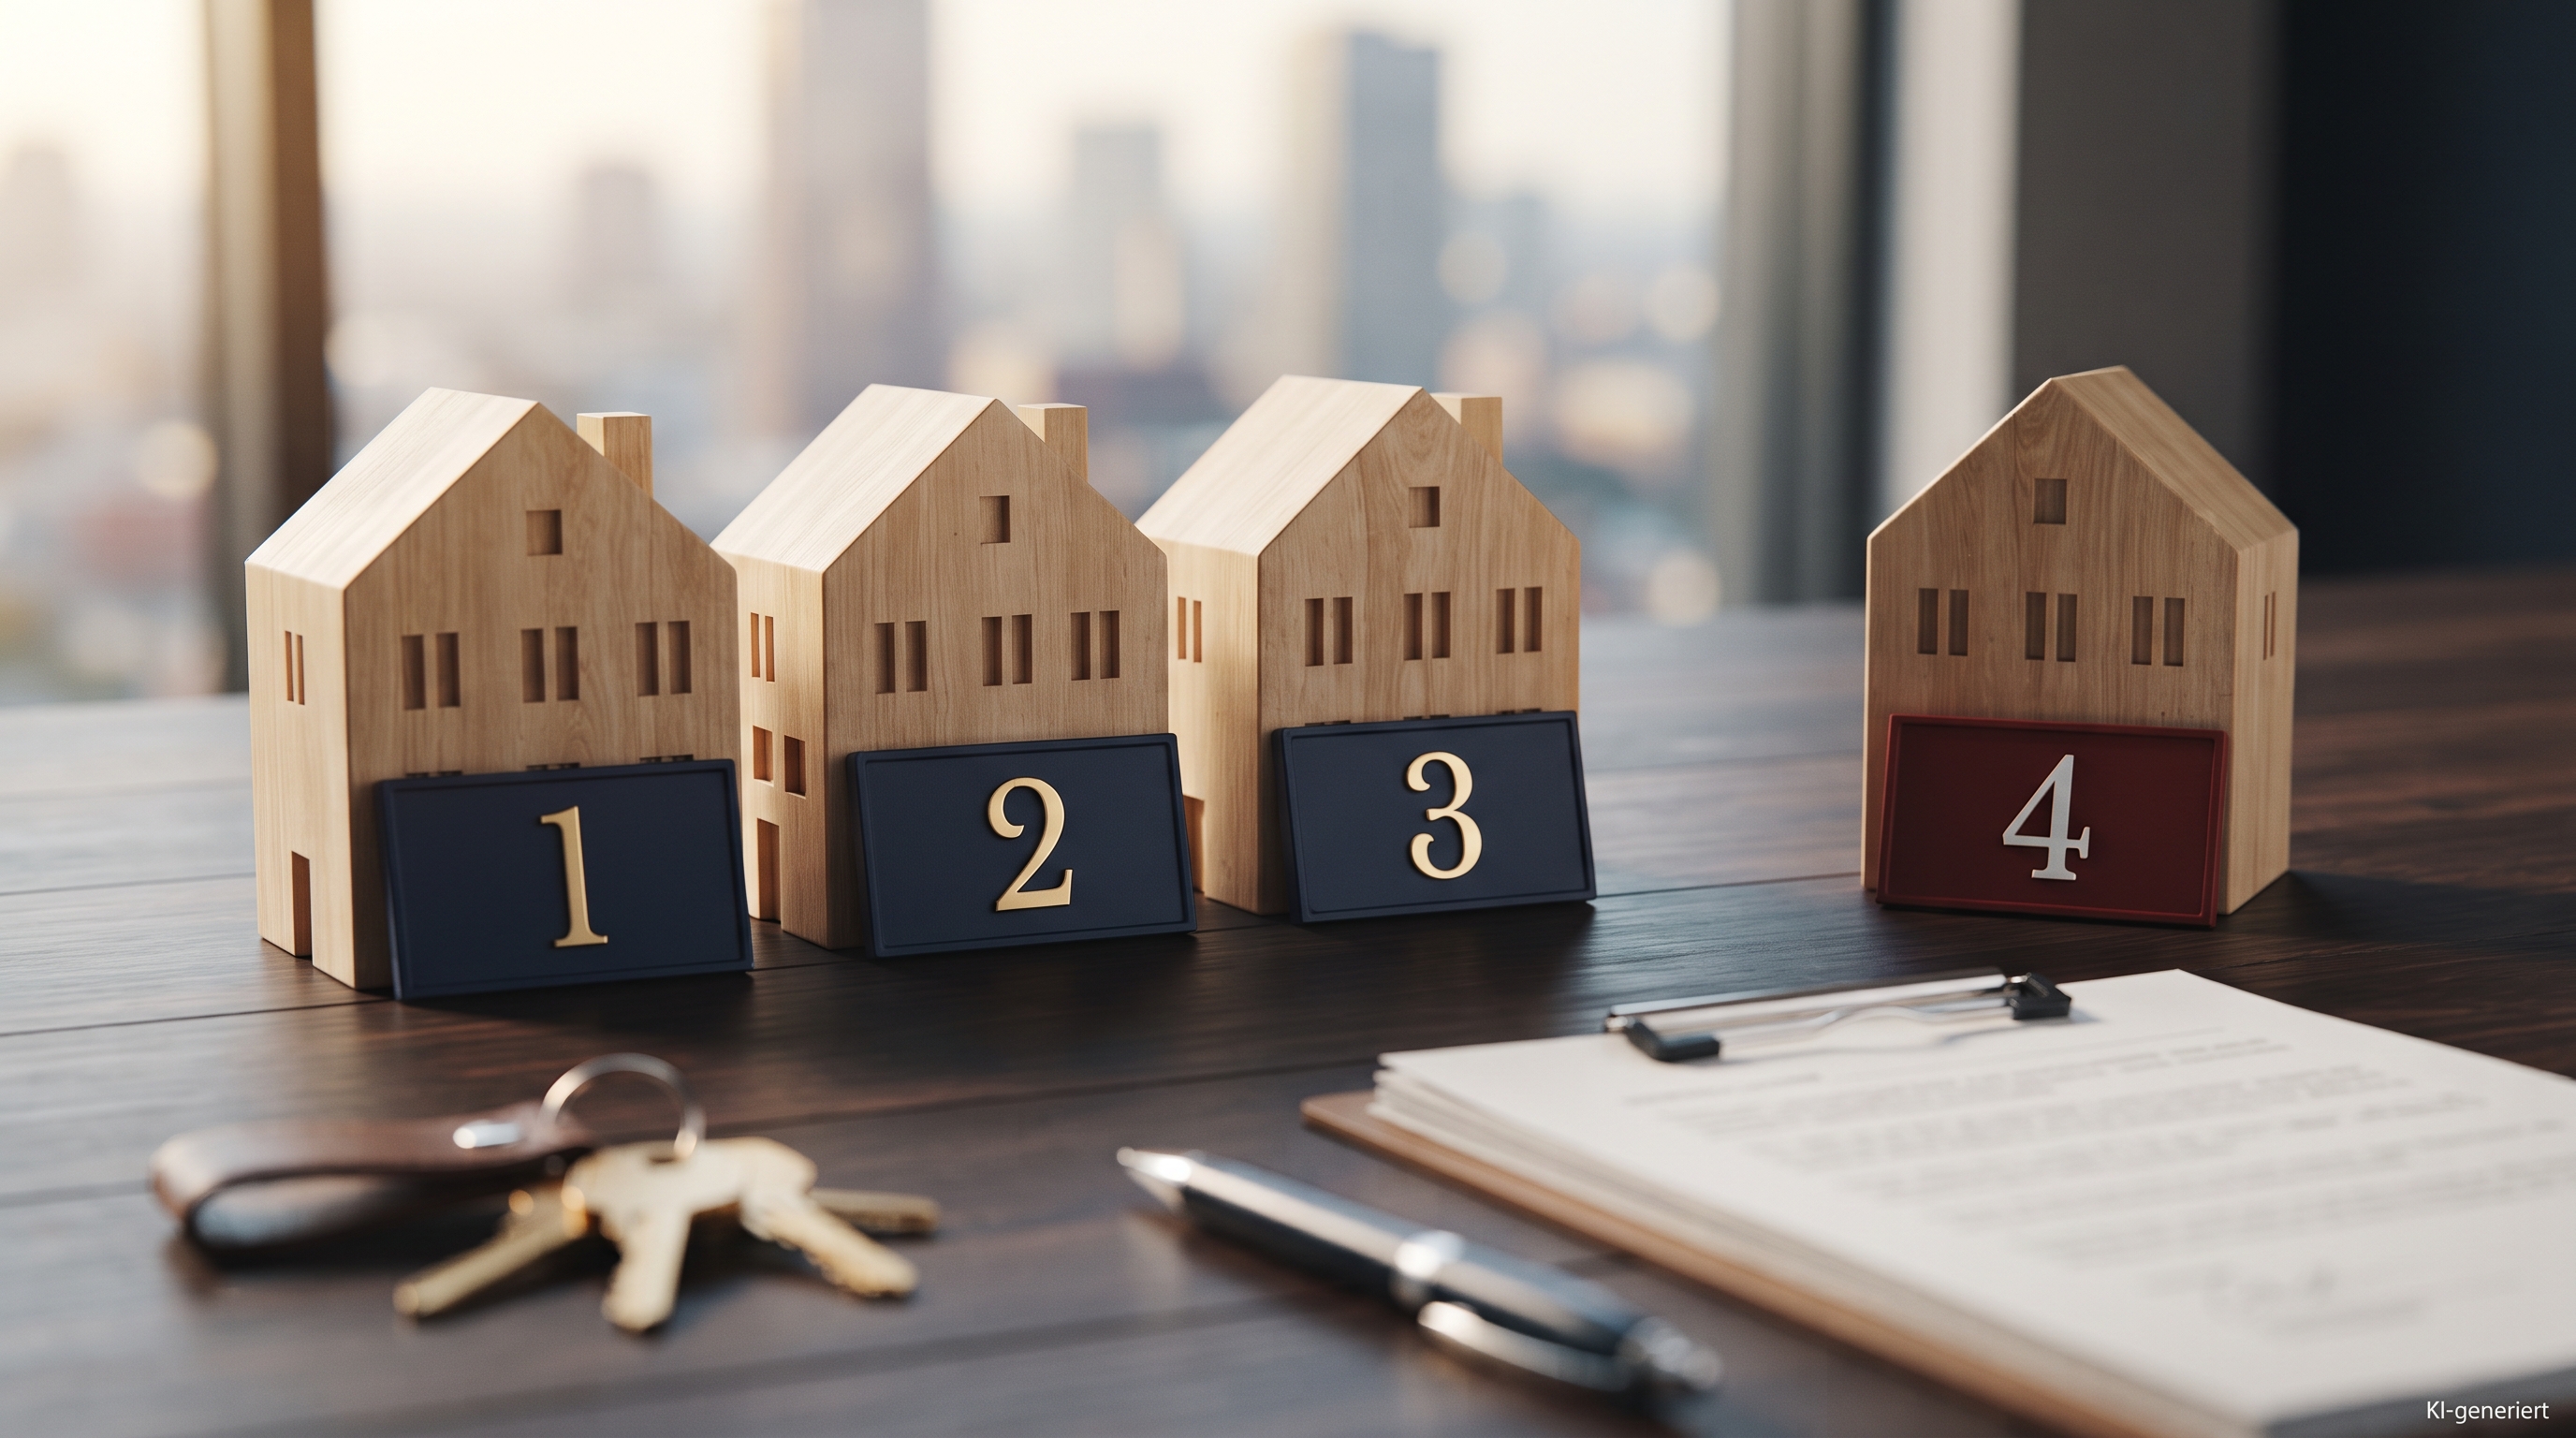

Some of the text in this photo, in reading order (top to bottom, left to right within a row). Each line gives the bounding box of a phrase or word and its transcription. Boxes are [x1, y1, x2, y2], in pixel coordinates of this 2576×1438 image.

[540, 805, 608, 947] 1
[987, 777, 1073, 911] 2
[1406, 751, 1482, 879] 3
[2001, 754, 2090, 881] 4
